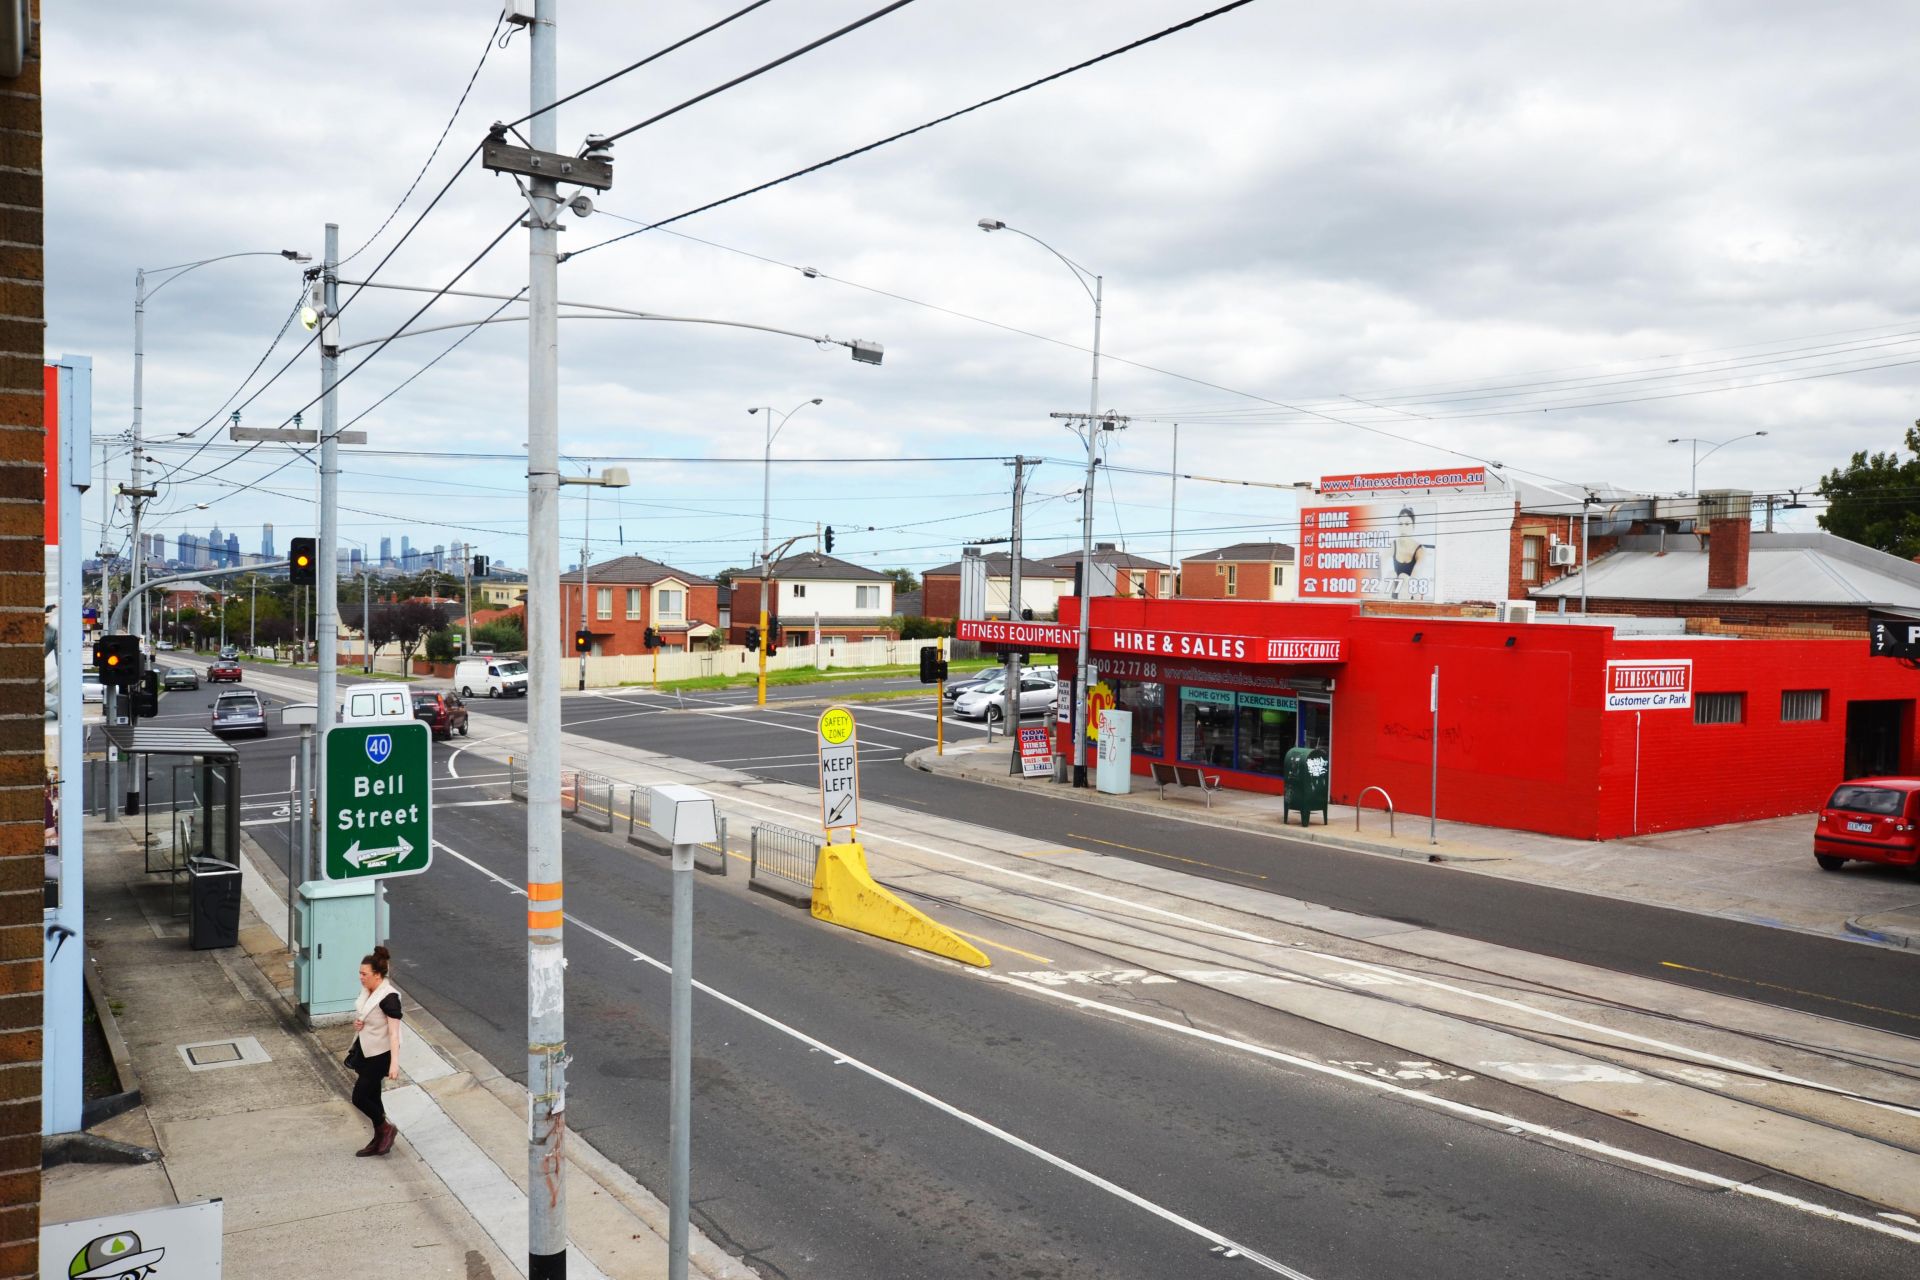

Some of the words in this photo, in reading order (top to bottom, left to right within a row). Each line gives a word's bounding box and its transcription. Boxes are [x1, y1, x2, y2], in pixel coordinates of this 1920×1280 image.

[1322, 472, 1483, 490] www.fitnesschoice.com.au
[1318, 512, 1349, 528] HOME
[1318, 531, 1391, 548] COMMERCIAL
[1318, 553, 1379, 569] CORPORATE
[1321, 578, 1357, 593] 1800
[1361, 578, 1379, 593] 22
[1383, 578, 1404, 593] 77
[1408, 578, 1429, 594] 88
[961, 623, 1005, 639] FITNESS
[1009, 626, 1080, 645] EQUIPMENT
[1113, 631, 1156, 651] HIRE
[1162, 635, 1173, 653] &
[1181, 636, 1245, 658] SALES
[1267, 643, 1305, 657] FITNESS
[1308, 643, 1340, 657] CHOICE
[1113, 660, 1126, 675] 22
[1128, 661, 1141, 676] 77
[1143, 663, 1157, 678] 88
[1615, 671, 1650, 687] FITNESS
[1654, 671, 1685, 687] CHOICE
[1188, 689, 1209, 699] HOME
[1210, 691, 1230, 701] GYMS
[1240, 695, 1275, 706] EXERCISE
[1276, 698, 1297, 709] BIKES
[1609, 695, 1650, 706] Customer
[1653, 694, 1667, 705] Car
[1669, 693, 1687, 704] Park
[824, 716, 849, 727] SAFETY
[828, 729, 846, 739] ZONE
[369, 738, 389, 755] 40
[823, 757, 853, 772] KEEP
[354, 774, 404, 798] Bell
[825, 777, 853, 792] LEFT
[338, 804, 419, 830] Street
